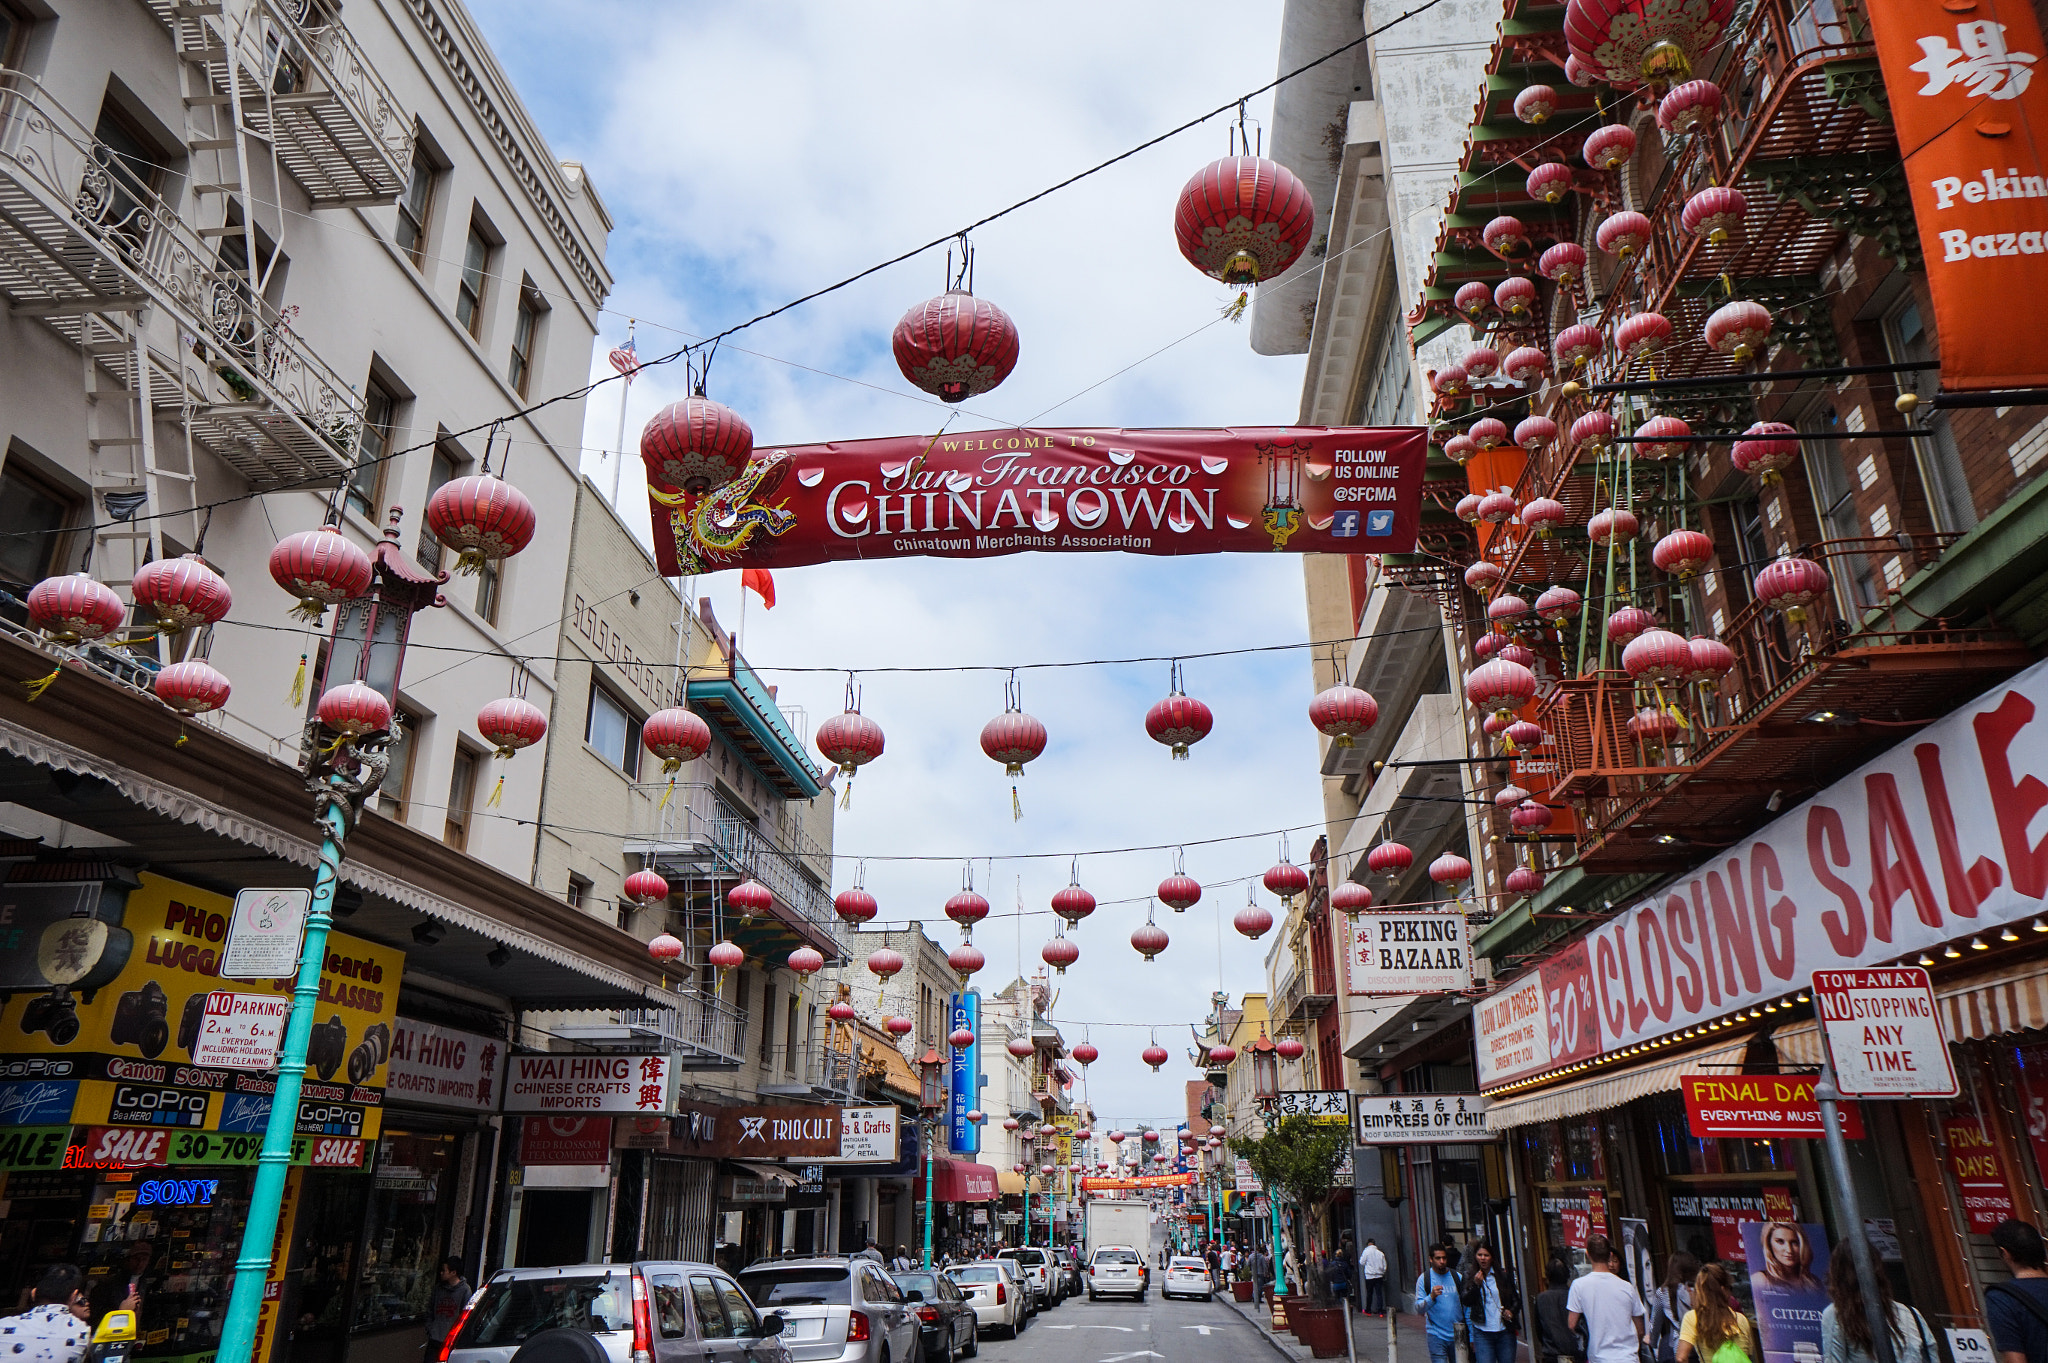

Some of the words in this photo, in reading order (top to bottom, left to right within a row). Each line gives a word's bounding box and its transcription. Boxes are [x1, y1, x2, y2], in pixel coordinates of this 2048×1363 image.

[1909, 20, 2038, 100] 場
[1931, 167, 2048, 210] Pekin
[1939, 228, 2048, 263] Baza
[943, 436, 1055, 452] WELCOME
[1068, 435, 1096, 448] TO
[1335, 450, 1386, 463] FOLLOW
[882, 454, 961, 492] San
[975, 452, 1200, 487] Francisco
[1335, 466, 1352, 479] US
[1355, 466, 1399, 479] ONLINE
[1333, 486, 1397, 502] @SFCMA
[825, 480, 1220, 538] CHINATOWN
[894, 535, 971, 552] Chinatown
[976, 532, 1057, 549] Merchants
[1061, 534, 1152, 549] Association
[1597, 842, 1797, 1040] CLOSING
[1805, 690, 2048, 959] SALE
[1378, 920, 1458, 942] PEKING
[1356, 931, 1371, 963] 北京
[1378, 948, 1464, 970] BAZAAR
[1545, 949, 1584, 985] EVERYTHING
[1367, 976, 1411, 985] DISCOUNT
[1416, 975, 1455, 984] IMPORTS
[1820, 972, 1919, 988] TOW-AWAY
[207, 994, 231, 1014] NO
[233, 1001, 284, 1017] PARKING
[1480, 1006, 1496, 1036] LOW
[1495, 998, 1512, 1029] LOW
[1510, 984, 1539, 1022] PRICES
[1822, 992, 1851, 1020] NO
[1854, 996, 1930, 1019] STOPPING
[221, 1037, 258, 1047] EVERYDAY
[954, 1008, 969, 1073] citnk
[1490, 1035, 1508, 1053] DIRECT
[1507, 1030, 1523, 1047] FROM
[1523, 1024, 1535, 1041] THE
[1863, 1025, 1904, 1046] ANY
[202, 1045, 238, 1054] INCLUDING
[240, 1046, 273, 1056] HOLIDAYS
[202, 1055, 230, 1064] STREET
[232, 1056, 269, 1066] CLEANING
[418, 1033, 467, 1071] HING
[1495, 1053, 1513, 1071] ORIENT
[1513, 1051, 1521, 1065] TO
[1521, 1046, 1534, 1062] YOU
[1863, 1050, 1917, 1073] TIME
[107, 1057, 167, 1083] Canon
[174, 1066, 228, 1088] SONY
[520, 1058, 565, 1080] WAI
[570, 1058, 630, 1080] HING
[398, 1073, 436, 1094] CRAFTS
[438, 1078, 474, 1100] IMPORTS
[514, 1082, 573, 1095] CHINESE
[576, 1082, 631, 1095] CRAFTS
[635, 1055, 665, 1111] 偉興
[1693, 1082, 1769, 1102] FINAL
[117, 1087, 206, 1112] GoPro
[351, 1086, 382, 1105] Nikon
[540, 1096, 602, 1108] IMPORTS
[113, 1110, 121, 1120] Be
[129, 1111, 152, 1121] HERO
[229, 1097, 252, 1119] Maui
[299, 1103, 362, 1125] GoPro
[1700, 1109, 1782, 1121] EVERYTHING
[1787, 1111, 1822, 1122] MUST
[296, 1122, 304, 1131] Be
[308, 1122, 323, 1132] HERO
[853, 1121, 861, 1134] &
[864, 1120, 891, 1134] Crafts
[1363, 1113, 1429, 1129] EMPRESS
[1434, 1113, 1451, 1126] OF
[1455, 1112, 1486, 1126] CHIN
[93, 1128, 166, 1161] SALE
[529, 1140, 550, 1150] RED
[553, 1139, 601, 1150] BLOSSOM
[1364, 1130, 1381, 1139] ROOF
[1384, 1130, 1409, 1138] GARDEN
[1947, 1127, 1994, 1149] FINAL
[0, 1132, 65, 1168] ALE
[314, 1139, 361, 1165] SALE
[528, 1151, 549, 1161] TEA
[549, 1150, 601, 1161] COMPANY
[1955, 1154, 1999, 1178] DAYS!
[510, 1170, 521, 1185] 831
[137, 1180, 219, 1206] SONY
[1589, 1195, 1603, 1207] FINAL
[1764, 1193, 1791, 1211] FINAL
[1964, 1196, 2011, 1210] EVERYTHING
[1672, 1197, 1700, 1217] ELEGANT
[1973, 1212, 1995, 1223] MUST
[1711, 1214, 1726, 1226] closing
